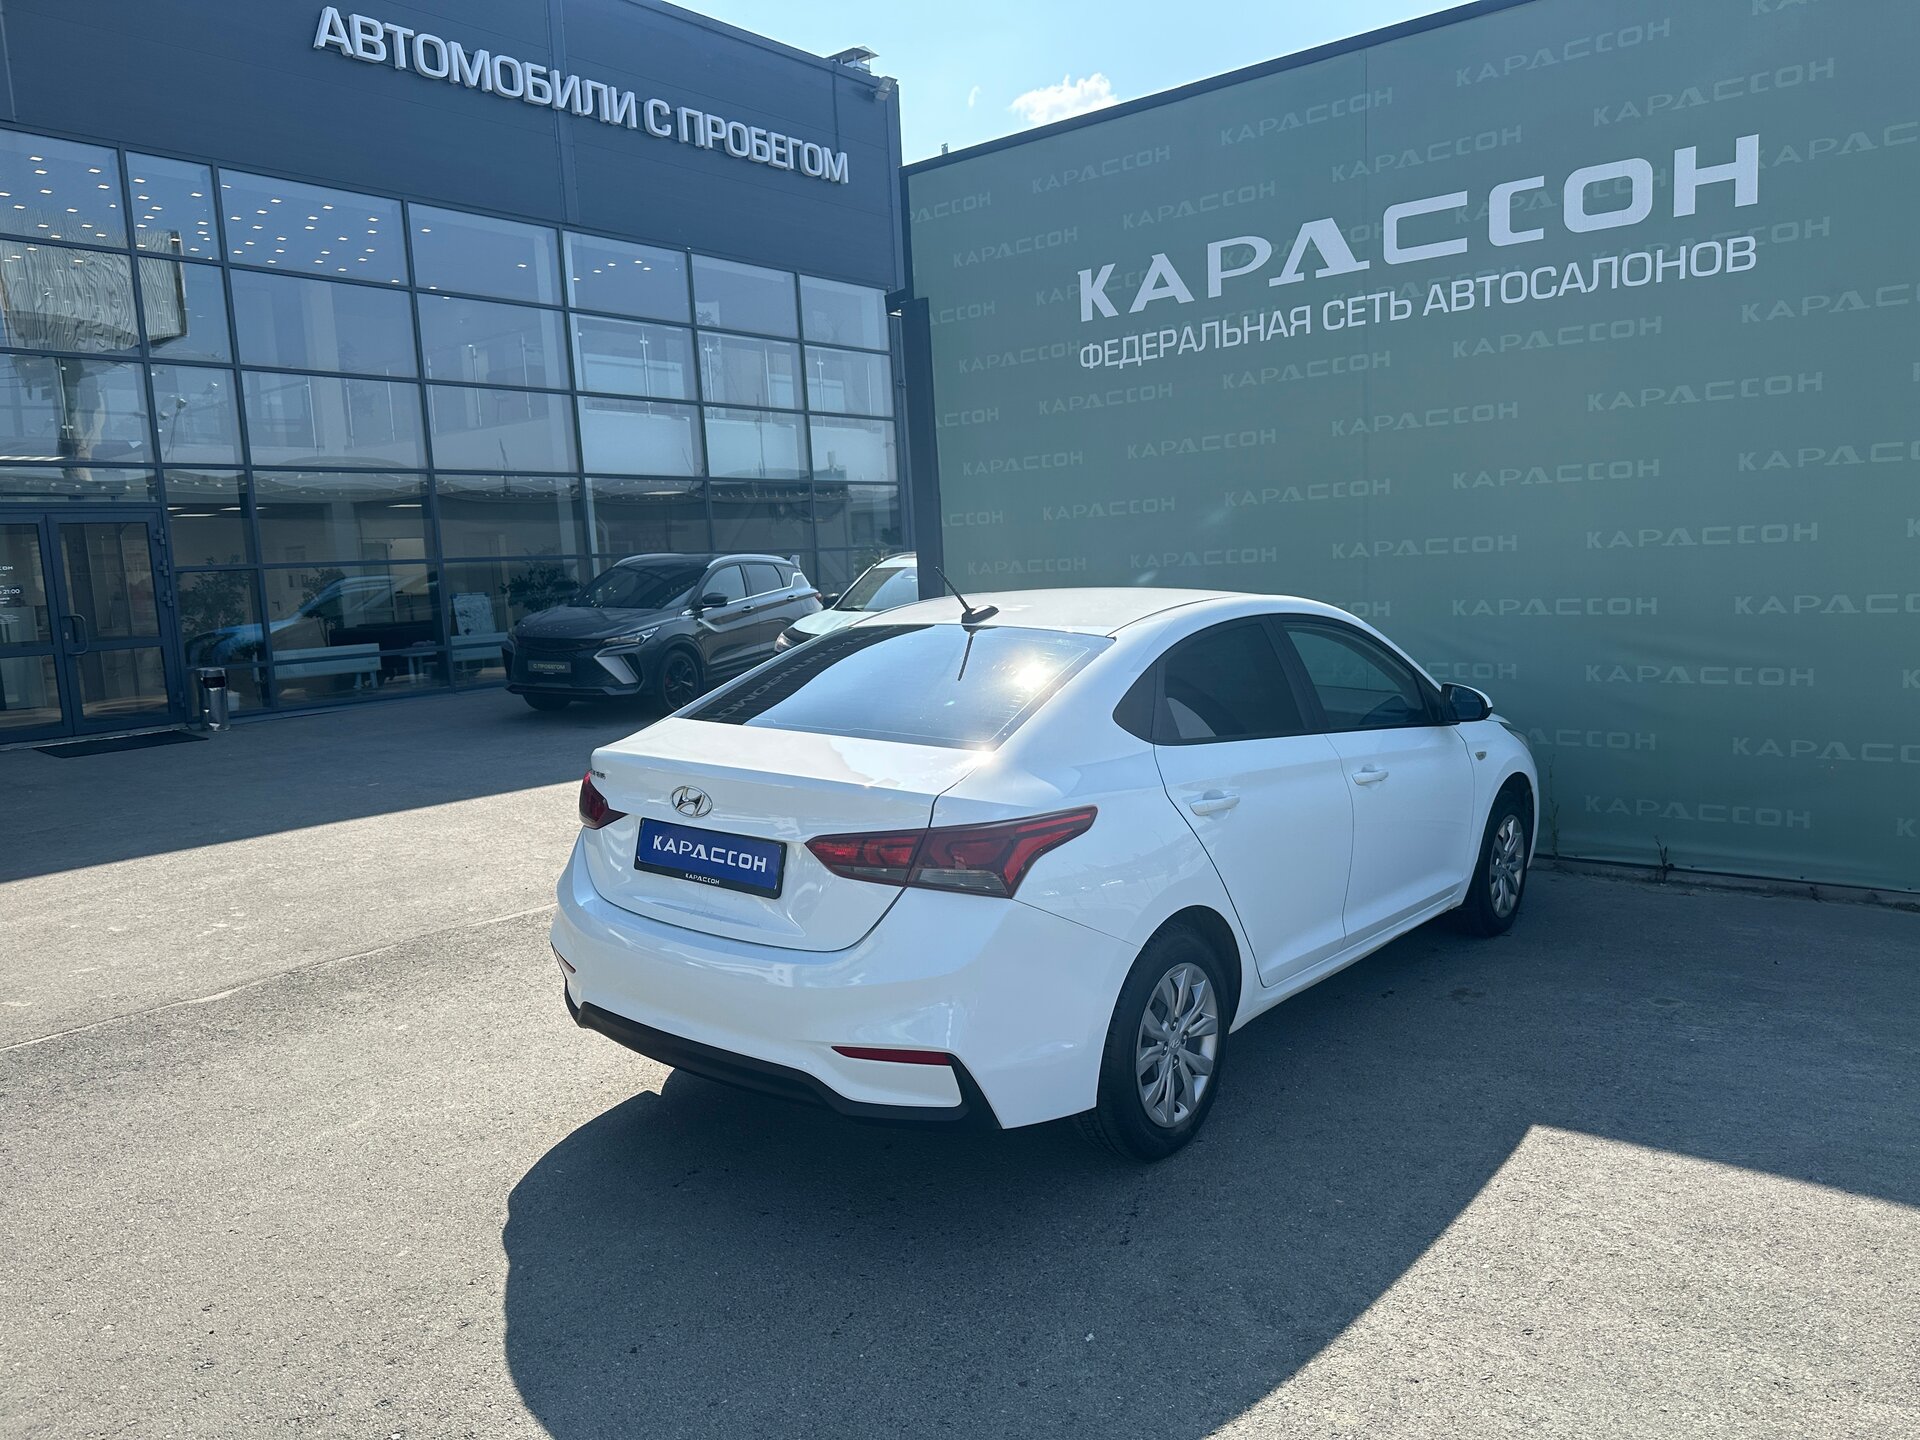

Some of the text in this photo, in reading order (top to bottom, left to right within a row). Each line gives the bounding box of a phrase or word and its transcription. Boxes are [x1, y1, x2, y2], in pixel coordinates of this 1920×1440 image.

[313, 6, 849, 184] АВТОМОБИЛИ С ПРОБЕГОМ
[1078, 134, 1759, 322] КАРАССОН
[1080, 305, 1311, 369] ФЕДЕРАЛЬНАЯ
[1322, 290, 1412, 331] СЕТЬ
[1423, 236, 1757, 316] АВТОСАЛОНОВ
[1741, 283, 1920, 324] КАРАС
[942, 510, 1004, 528] ССОН
[653, 835, 767, 872] КАРАССОН
